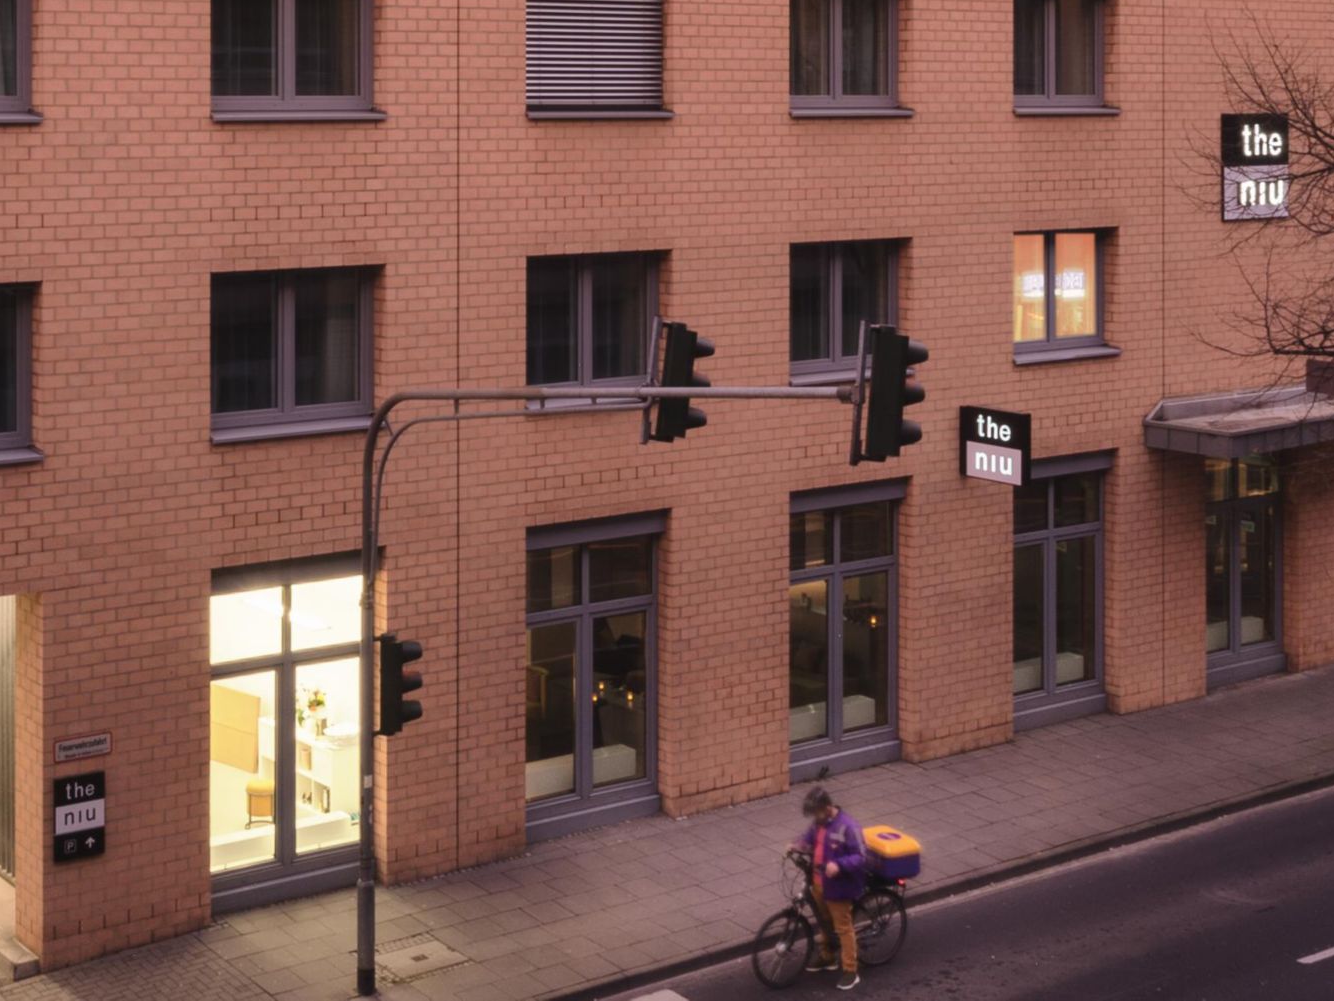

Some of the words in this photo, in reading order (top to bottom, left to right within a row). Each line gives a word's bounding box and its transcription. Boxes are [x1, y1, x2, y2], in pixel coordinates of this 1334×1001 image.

[1241, 123, 1283, 157] the
[1240, 180, 1284, 206] niu
[976, 414, 1011, 442] the
[975, 451, 1013, 476] niu
[66, 782, 95, 800] the
[64, 808, 96, 826] niu
